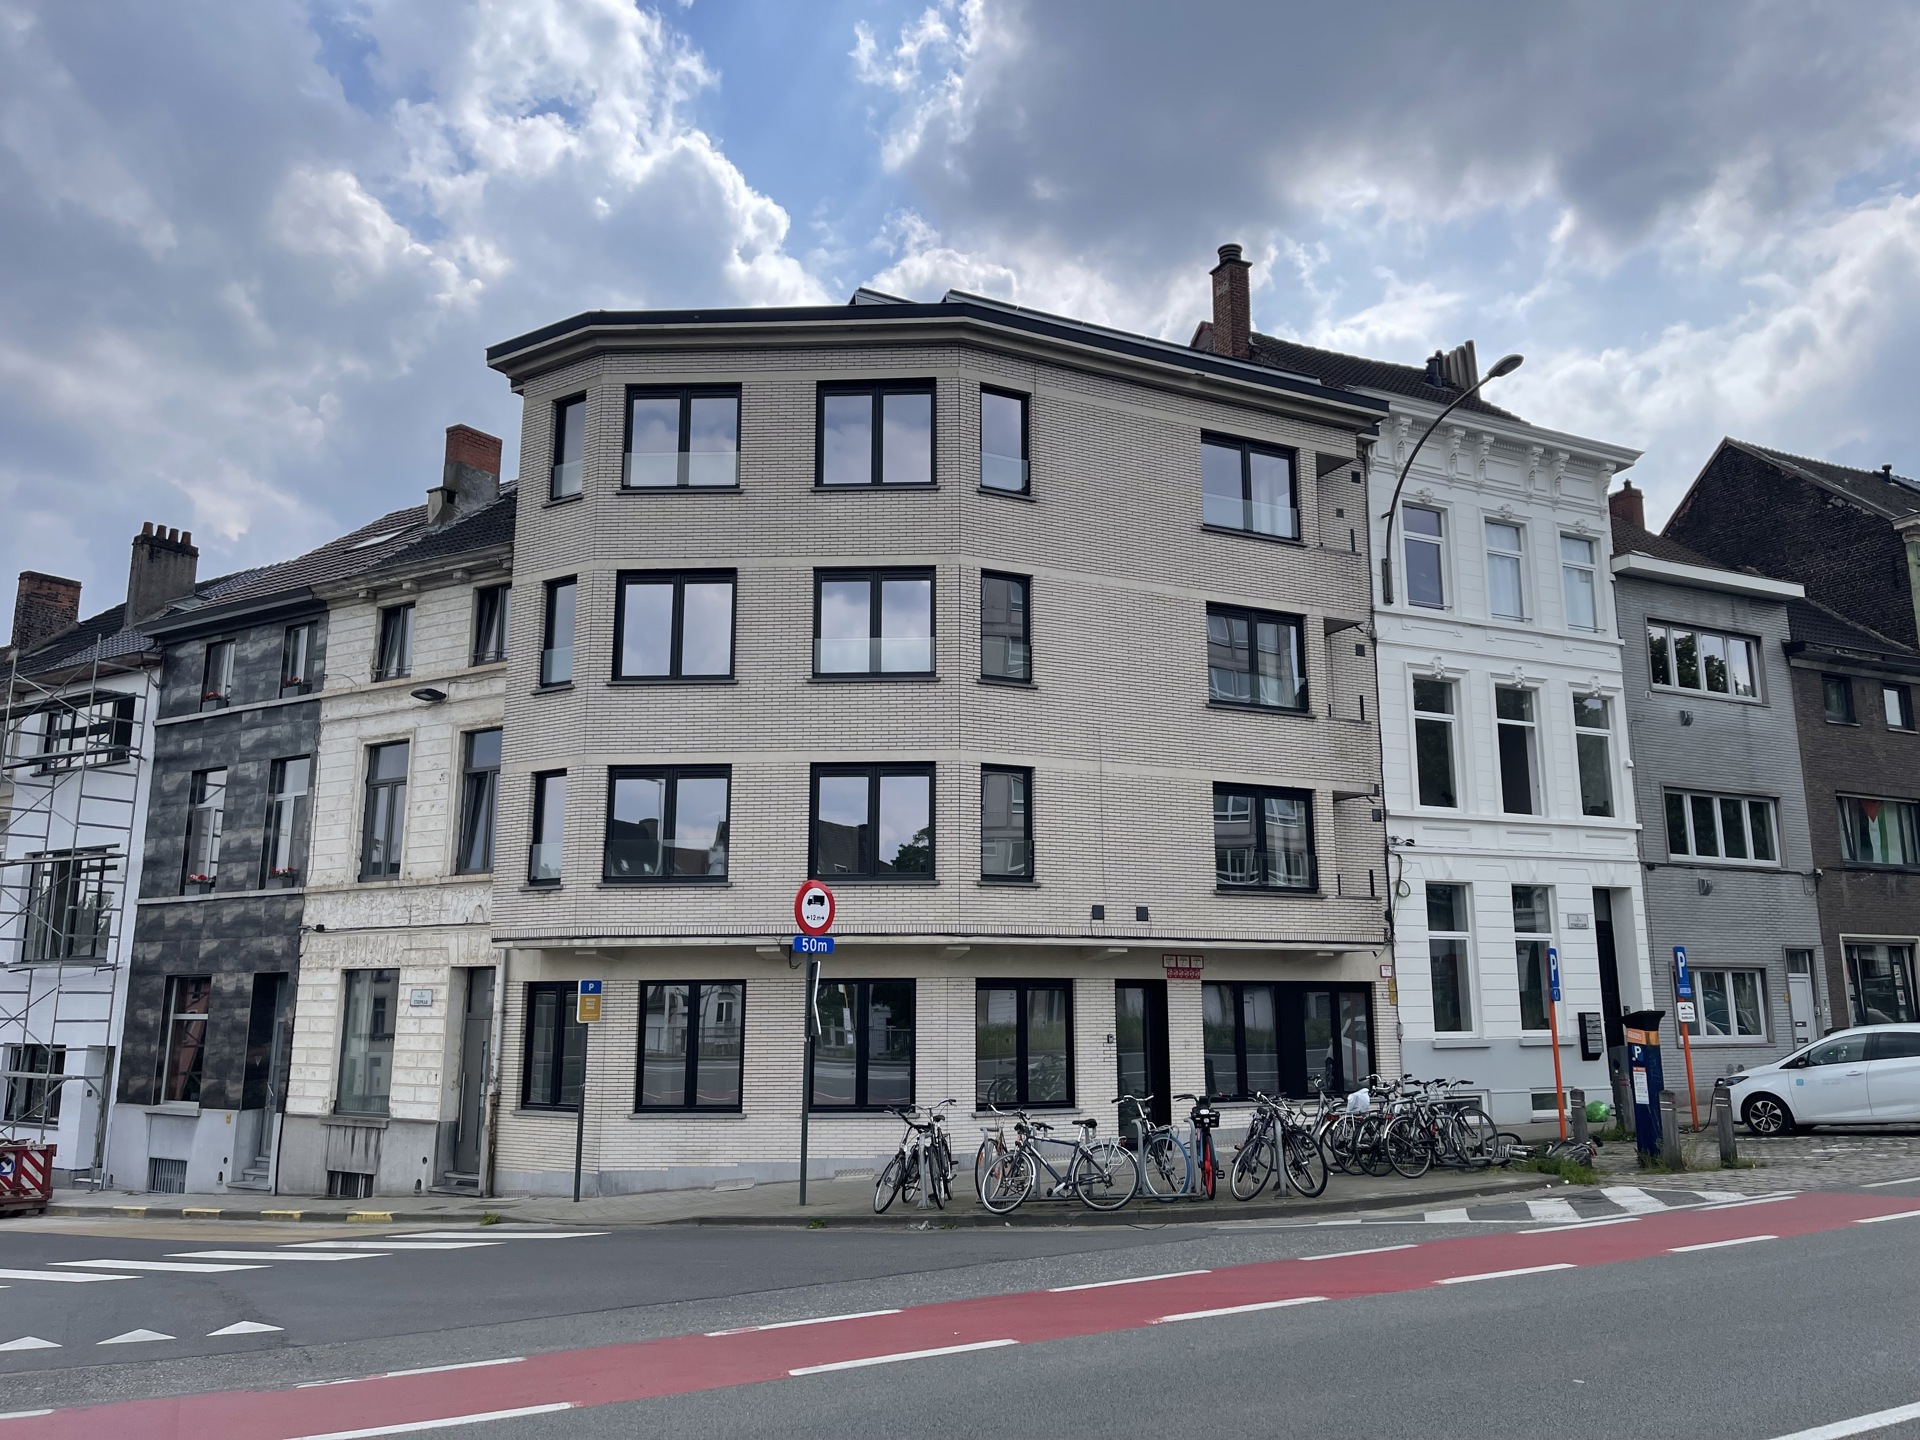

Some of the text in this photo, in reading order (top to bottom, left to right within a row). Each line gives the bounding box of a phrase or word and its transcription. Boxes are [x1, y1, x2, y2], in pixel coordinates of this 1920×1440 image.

[802, 938, 828, 952] 50m
[1549, 953, 1557, 982] P
[1677, 951, 1686, 978] P
[588, 983, 595, 991] P
[1634, 1045, 1642, 1059] P
